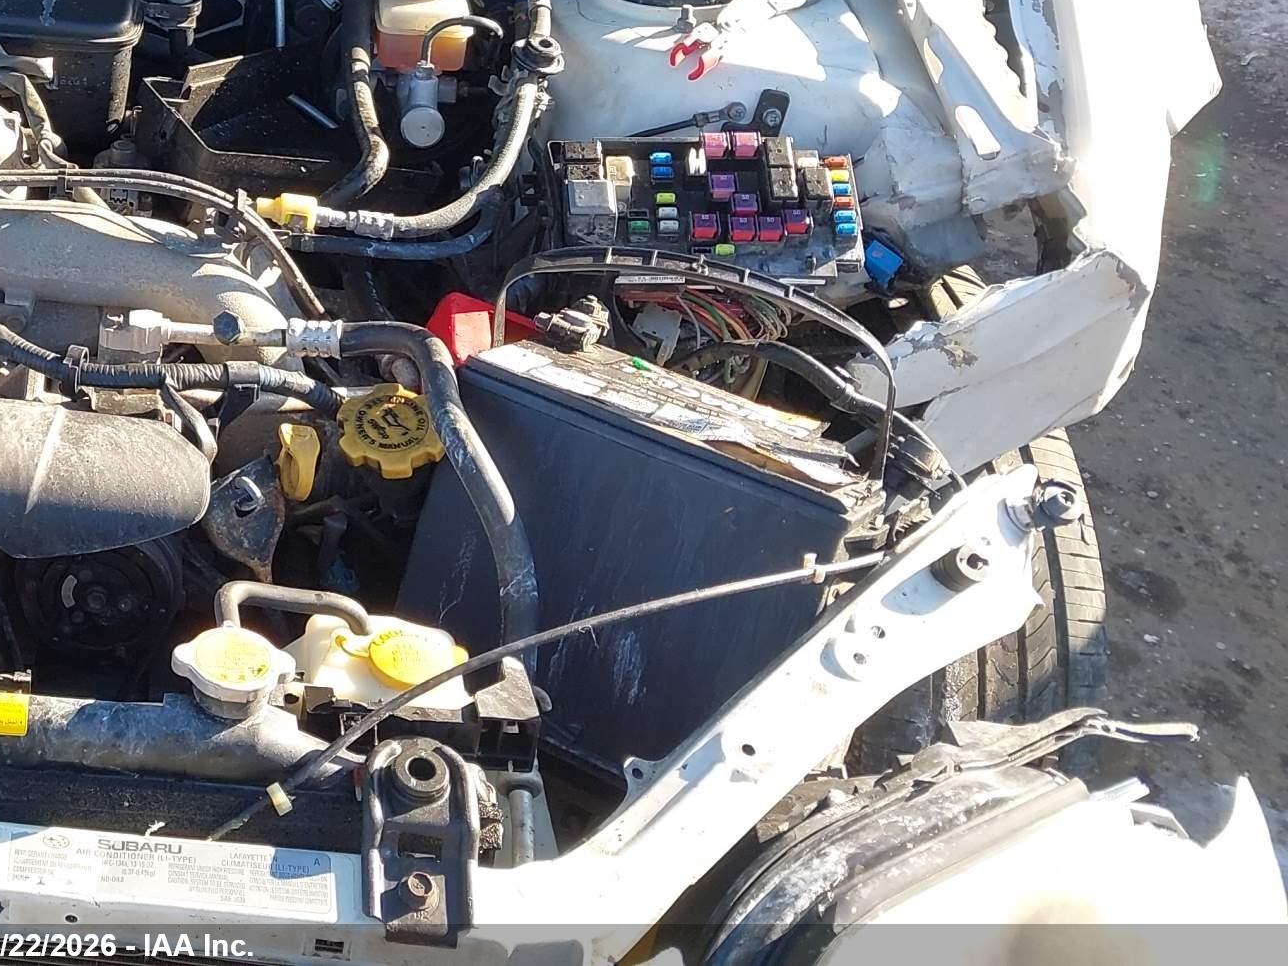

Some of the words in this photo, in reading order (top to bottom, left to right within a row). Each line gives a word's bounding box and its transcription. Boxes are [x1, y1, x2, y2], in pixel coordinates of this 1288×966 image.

[97, 839, 182, 854] SUBARU
[94, 850, 155, 861] CONDITIONER
[157, 854, 197, 865] (LI-TYPE)
[229, 852, 268, 862] LAFAYETTE
[277, 863, 310, 874] (LI-TYPE)
